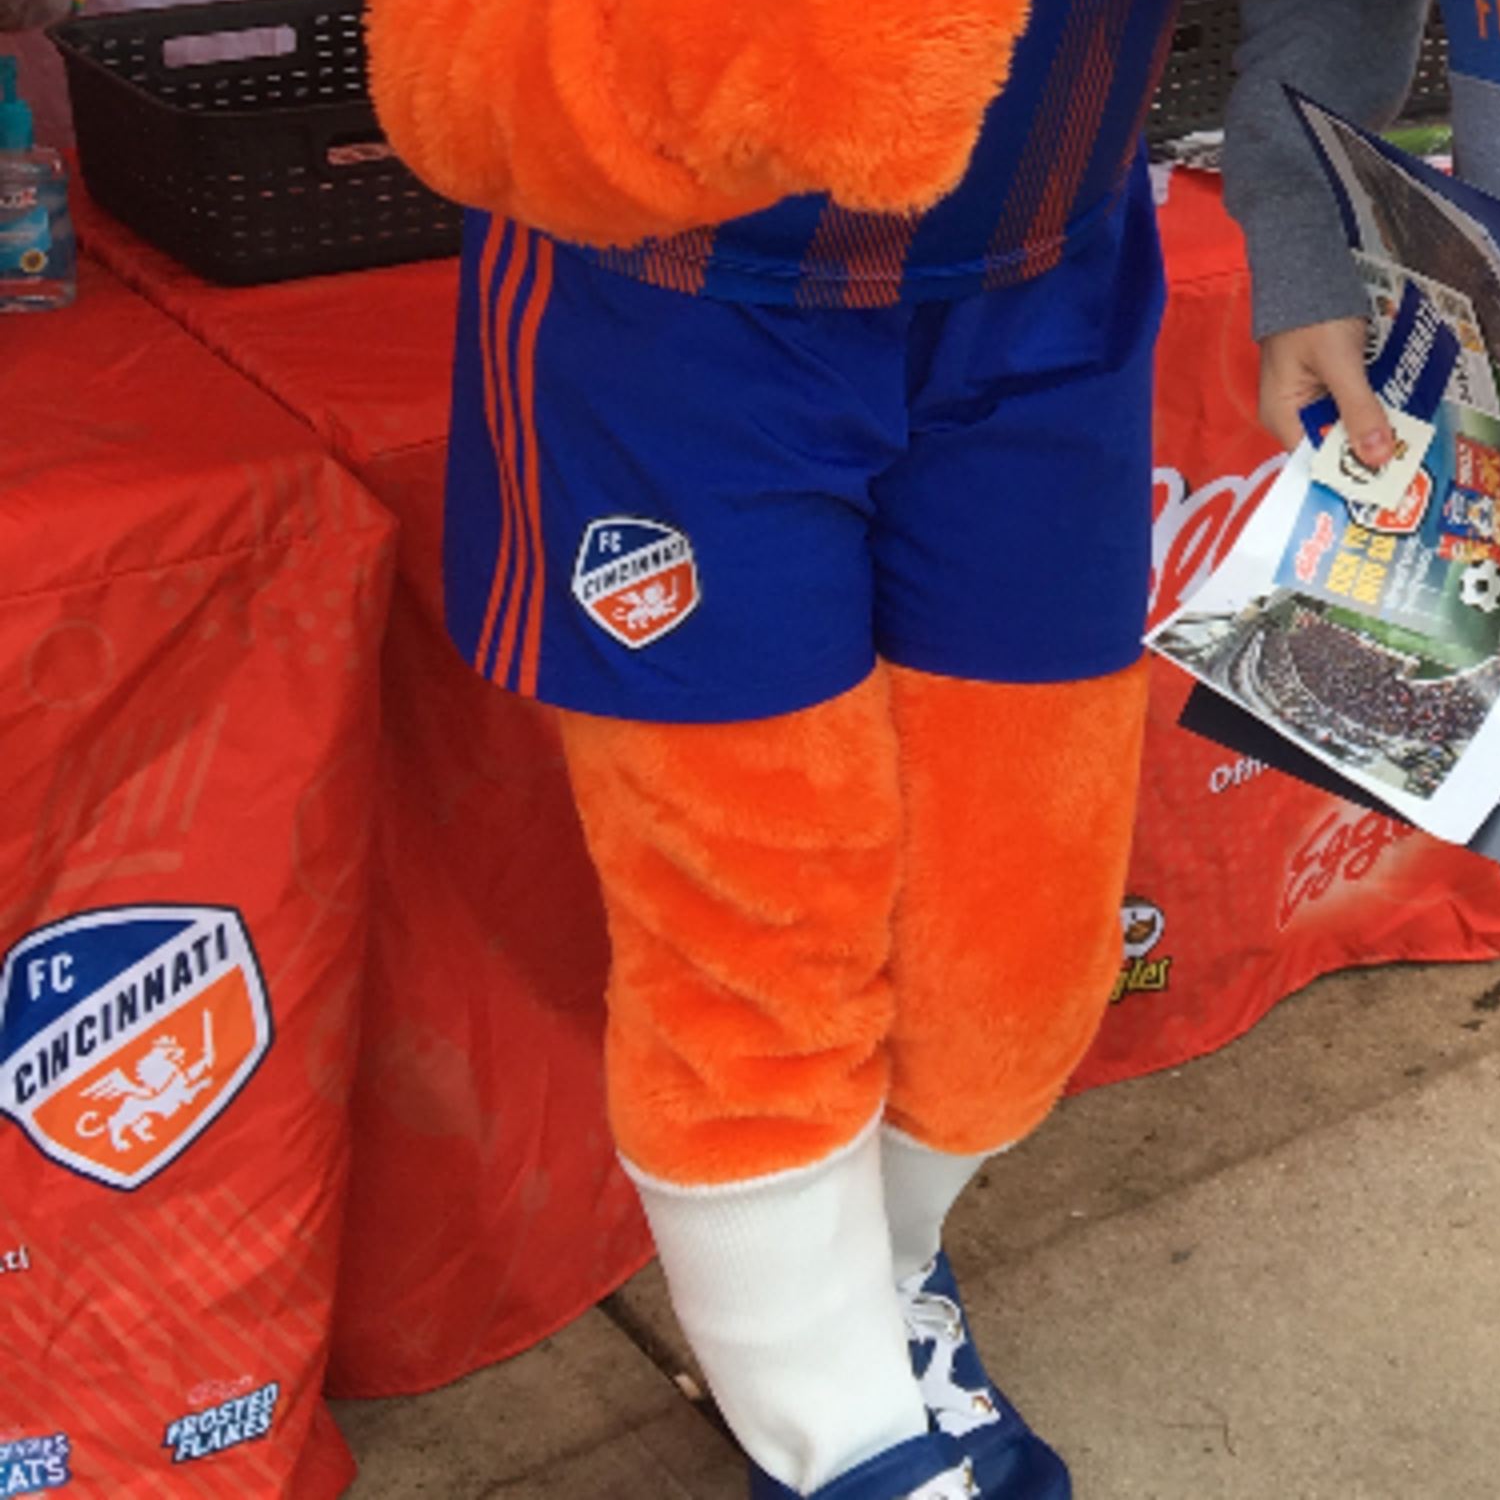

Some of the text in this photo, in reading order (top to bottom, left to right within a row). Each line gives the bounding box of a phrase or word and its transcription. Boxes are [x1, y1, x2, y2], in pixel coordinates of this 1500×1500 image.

[598, 530, 622, 554] FC
[28, 952, 75, 1001] FC
[13, 922, 229, 1105] CINCINNATI
